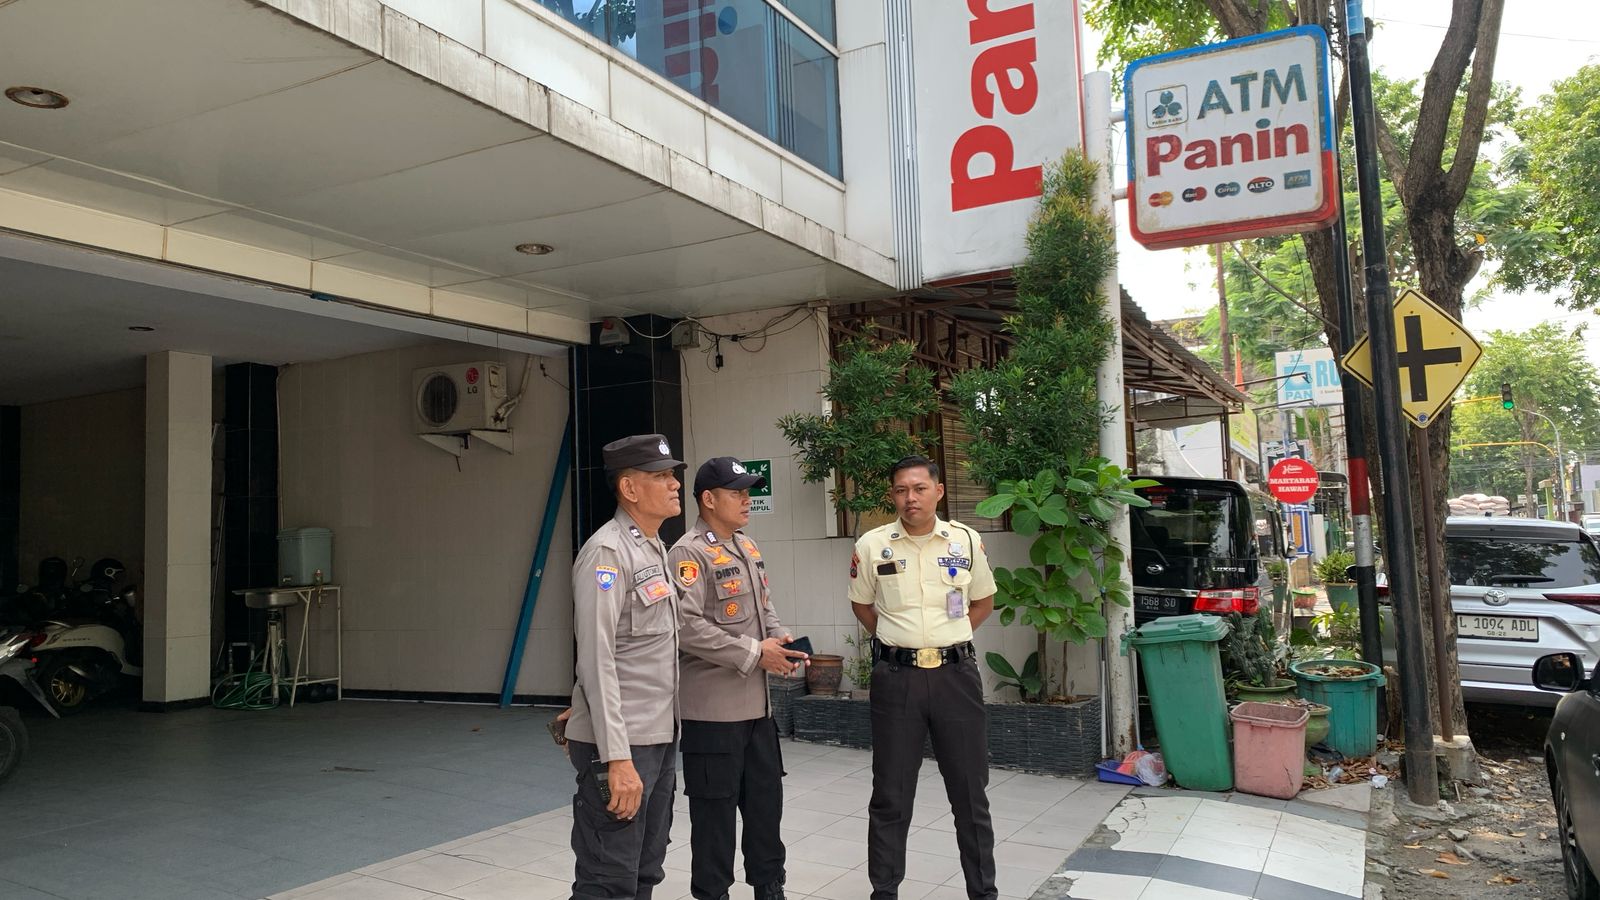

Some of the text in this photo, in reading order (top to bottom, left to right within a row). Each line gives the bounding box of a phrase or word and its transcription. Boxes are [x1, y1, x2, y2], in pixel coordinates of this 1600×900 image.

[1197, 63, 1308, 120] ATM
[1146, 118, 1310, 177] Panin
[1248, 181, 1273, 190] ALTO
[467, 386, 478, 394] LG
[1269, 477, 1318, 485] MARTABAK
[1141, 595, 1160, 606] 1568
[1459, 616, 1535, 632] L 1094 ADL
